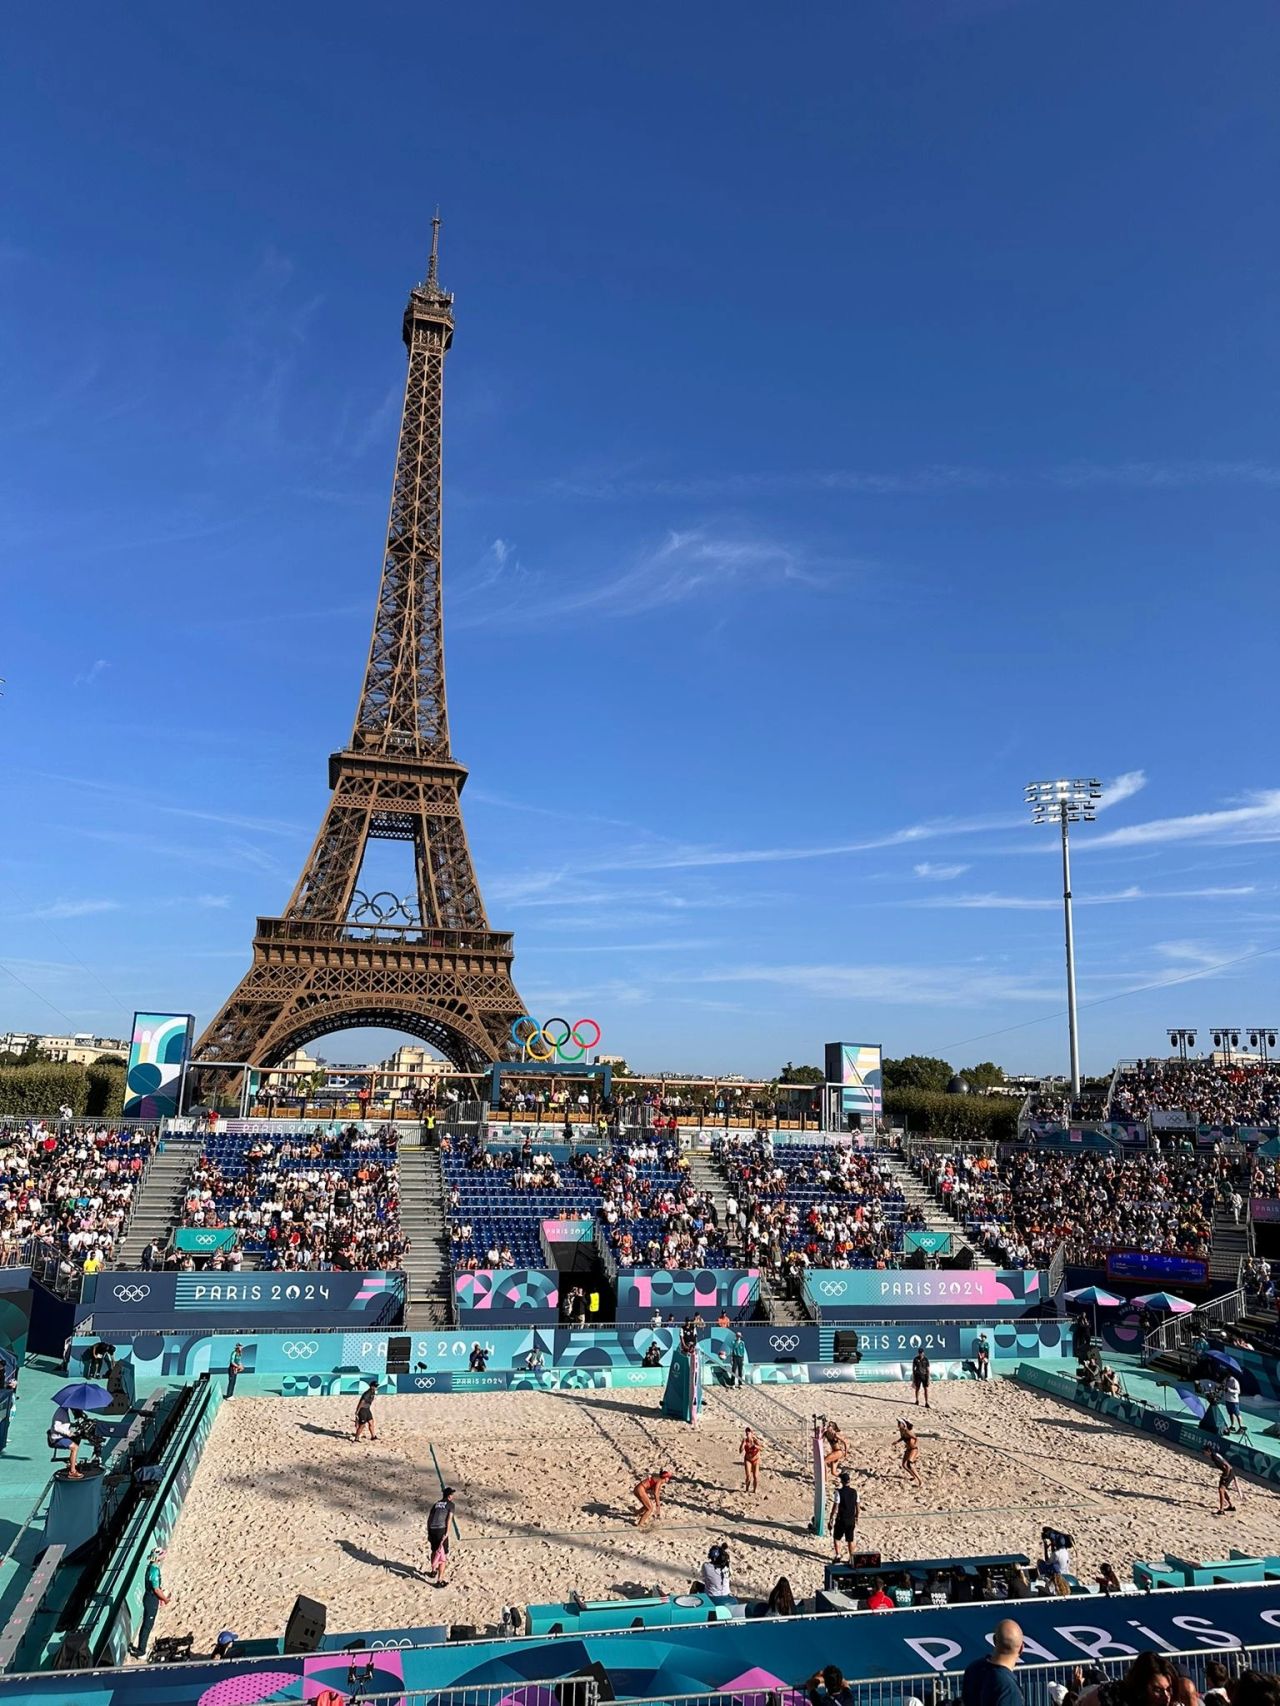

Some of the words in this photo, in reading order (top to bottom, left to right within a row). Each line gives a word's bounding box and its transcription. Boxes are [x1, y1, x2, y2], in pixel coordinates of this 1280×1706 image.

[271, 1285, 329, 1300] 2024
[939, 1282, 983, 1295] 2024
[898, 1334, 946, 1349] 2024
